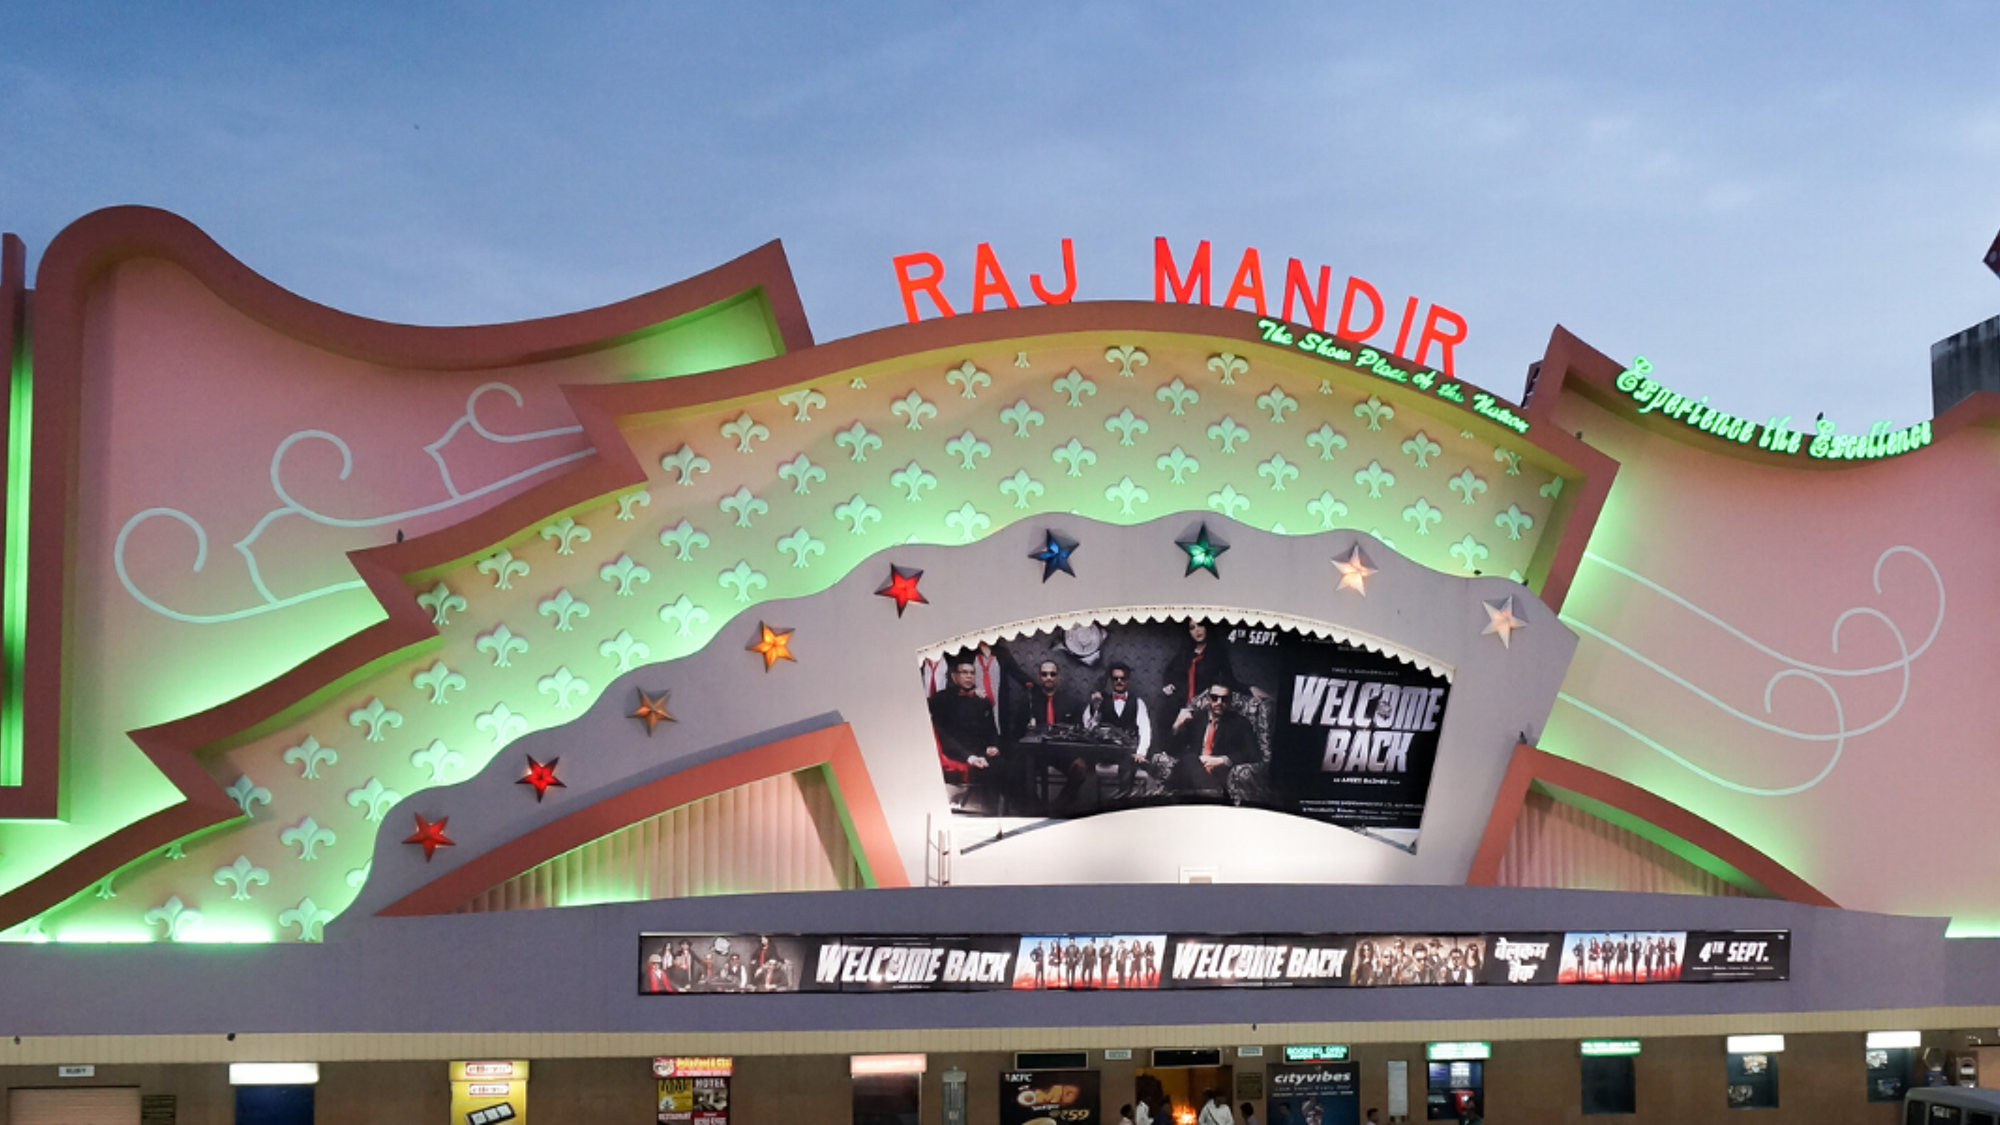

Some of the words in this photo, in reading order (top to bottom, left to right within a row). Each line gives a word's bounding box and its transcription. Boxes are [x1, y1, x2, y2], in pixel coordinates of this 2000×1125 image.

[893, 238, 1077, 323] RAJ
[1154, 236, 1468, 377] MANDIR
[1258, 319, 1293, 345] The
[1298, 332, 1351, 361] Show
[1355, 348, 1408, 382] Place
[1412, 370, 1436, 390] of
[1436, 383, 1465, 403] the
[1473, 392, 1529, 433] Nation
[1616, 355, 1757, 443] Experience
[1758, 415, 1803, 454] the
[1809, 419, 1933, 460] Excellence
[1247, 630, 1278, 646] SEPT.
[1290, 675, 1444, 732] WELCOME
[1321, 729, 1415, 772] BACK
[816, 944, 944, 983] WELCOME
[942, 949, 1011, 983] BACK
[1172, 943, 1287, 979] WELCOME
[1286, 947, 1347, 978] BACK
[1727, 941, 1769, 962] SEPT.
[696, 1078, 725, 1088] HOTEL
[1010, 1074, 1032, 1082] KFC
[1274, 1071, 1351, 1085] cityvibes
